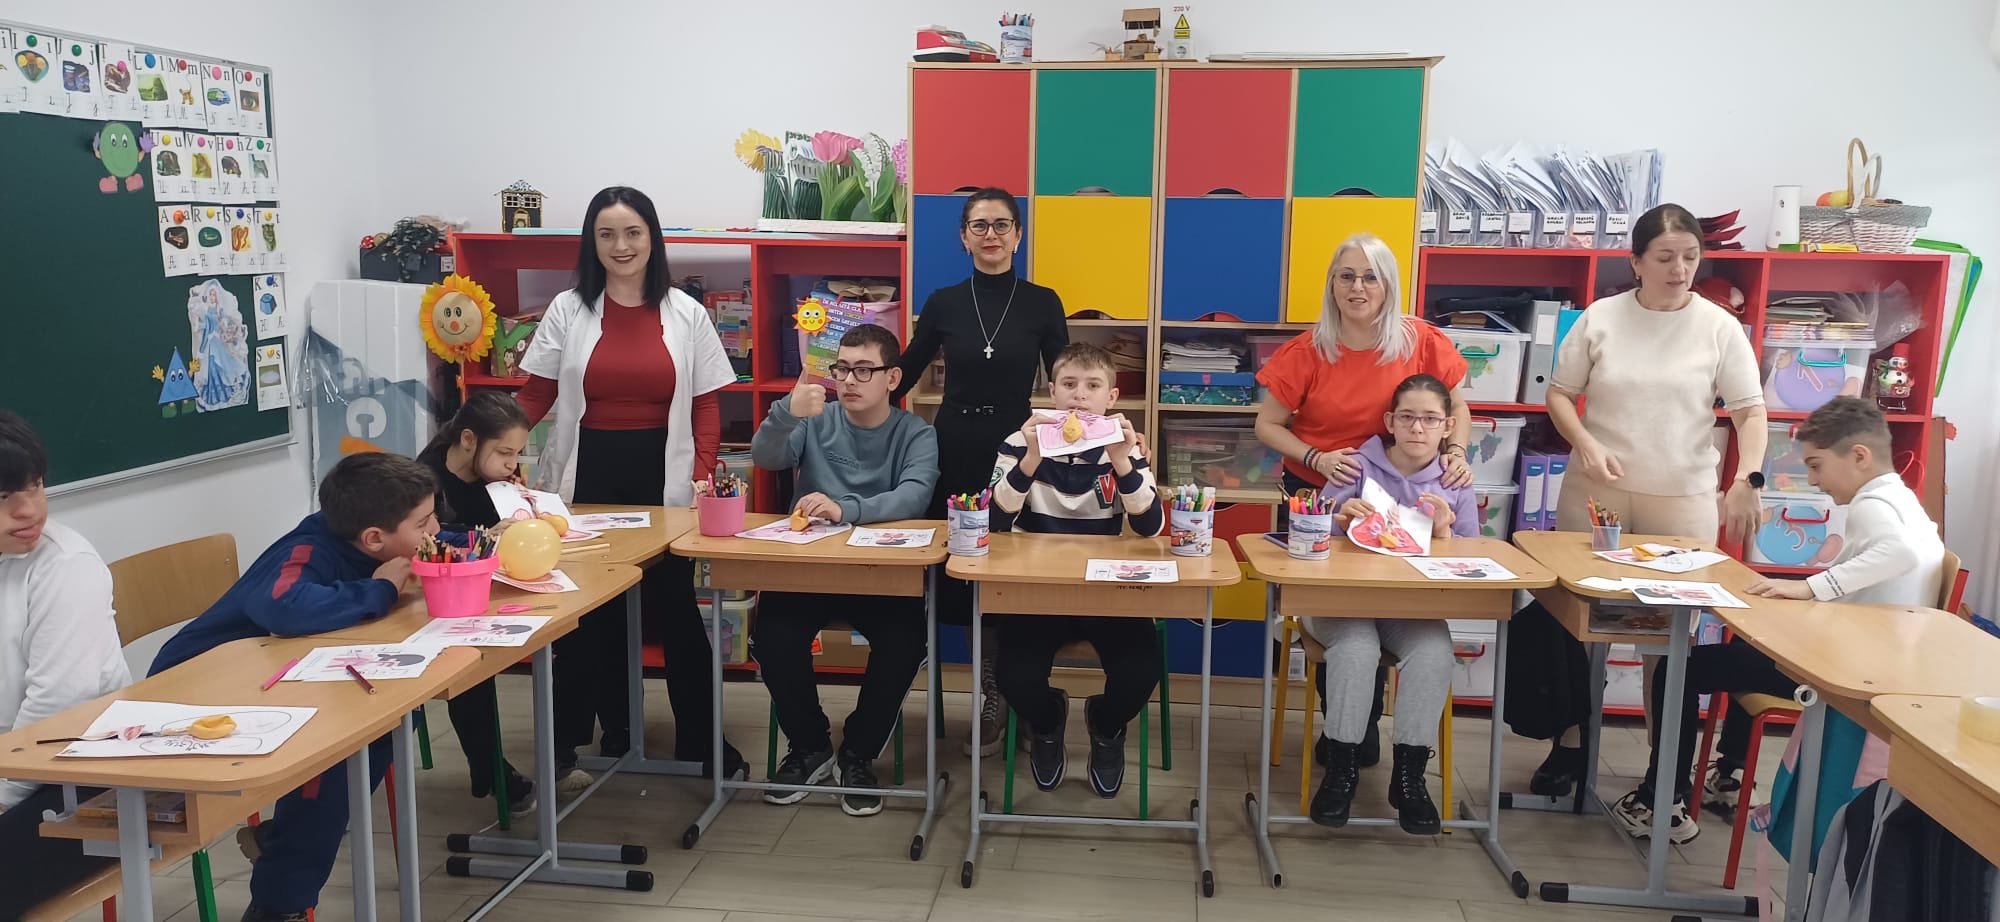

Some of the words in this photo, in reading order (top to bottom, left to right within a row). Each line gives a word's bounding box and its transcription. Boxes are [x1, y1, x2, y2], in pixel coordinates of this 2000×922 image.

[133, 55, 142, 70] L
[168, 57, 181, 73] M
[187, 64, 198, 75] m
[202, 65, 211, 80] N
[223, 70, 231, 81] n
[235, 70, 244, 84] O
[255, 77, 262, 87] o
[175, 137, 182, 147] u
[186, 133, 194, 148] V
[207, 140, 214, 149] v
[216, 136, 225, 151] H
[237, 137, 244, 151] h
[245, 135, 253, 151] Z
[265, 142, 272, 152] z
[160, 209, 169, 223] A
[183, 209, 190, 220] a
[193, 208, 201, 222] R
[216, 211, 222, 221] r
[255, 210, 261, 223] T
[275, 213, 280, 223] t
[254, 278, 262, 291] K
[256, 348, 262, 363] S
[275, 350, 281, 359] s
[1098, 471, 1117, 504] V
